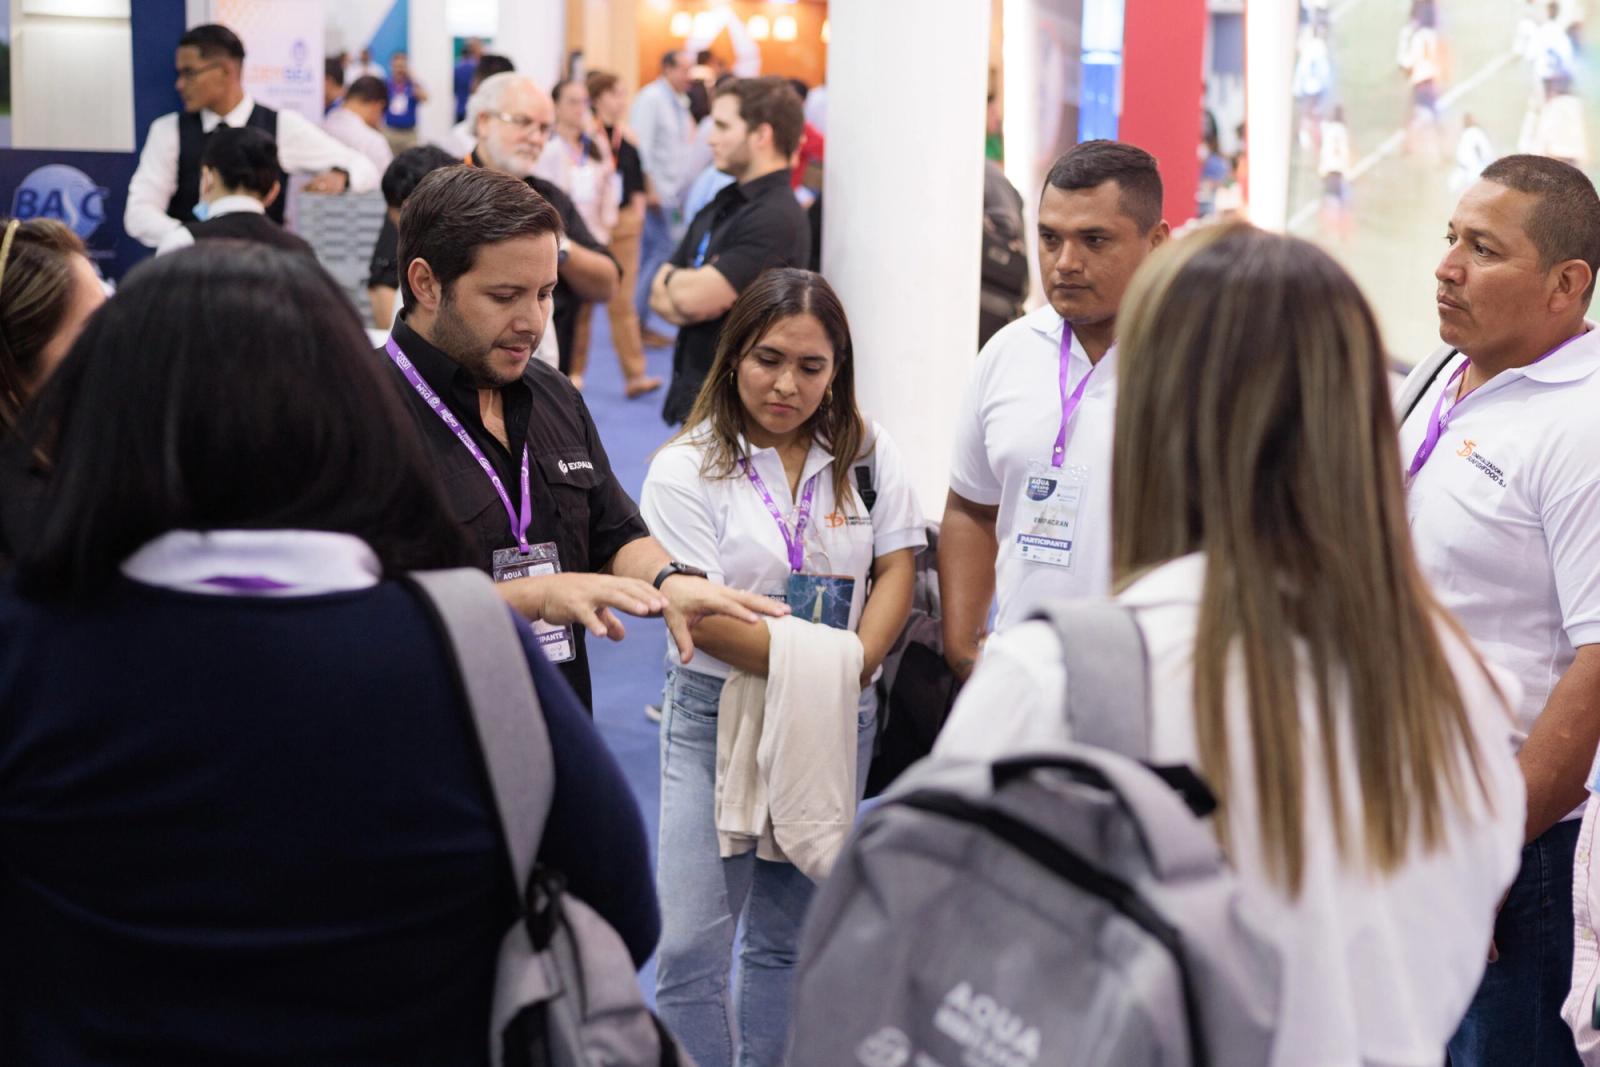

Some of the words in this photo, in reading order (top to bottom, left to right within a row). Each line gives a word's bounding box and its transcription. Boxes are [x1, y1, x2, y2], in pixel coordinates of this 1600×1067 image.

[1021, 535, 1067, 549] PARTICIPANTE
[503, 571, 522, 580] AQUA
[944, 981, 1041, 1061] AQUA
